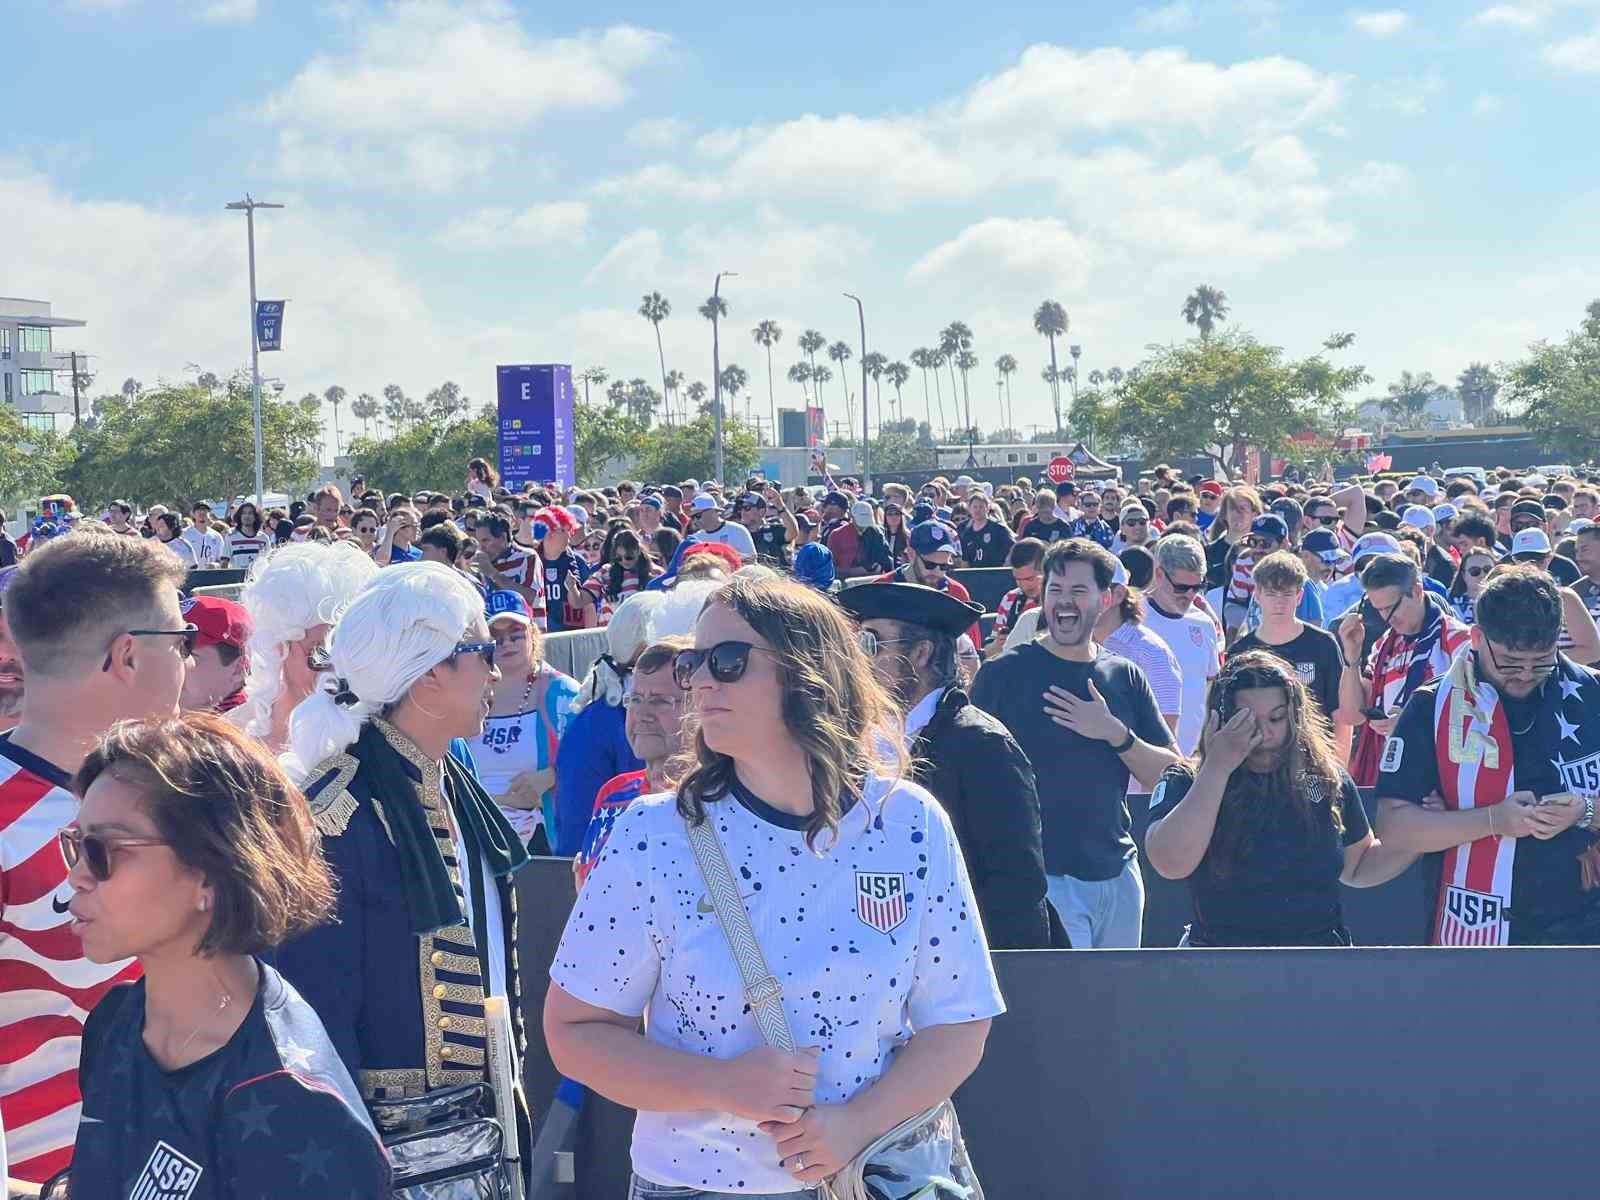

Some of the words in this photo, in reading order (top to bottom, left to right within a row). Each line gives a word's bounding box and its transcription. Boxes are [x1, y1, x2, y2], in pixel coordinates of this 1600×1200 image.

[263, 319, 275, 327] LOT
[264, 327, 274, 340] N
[521, 382, 531, 400] E
[1050, 464, 1073, 476] STOP
[546, 583, 561, 601] 10
[1566, 757, 1600, 791] US
[859, 875, 901, 900] USA
[1448, 890, 1498, 926] USA
[151, 1149, 196, 1191] USA
